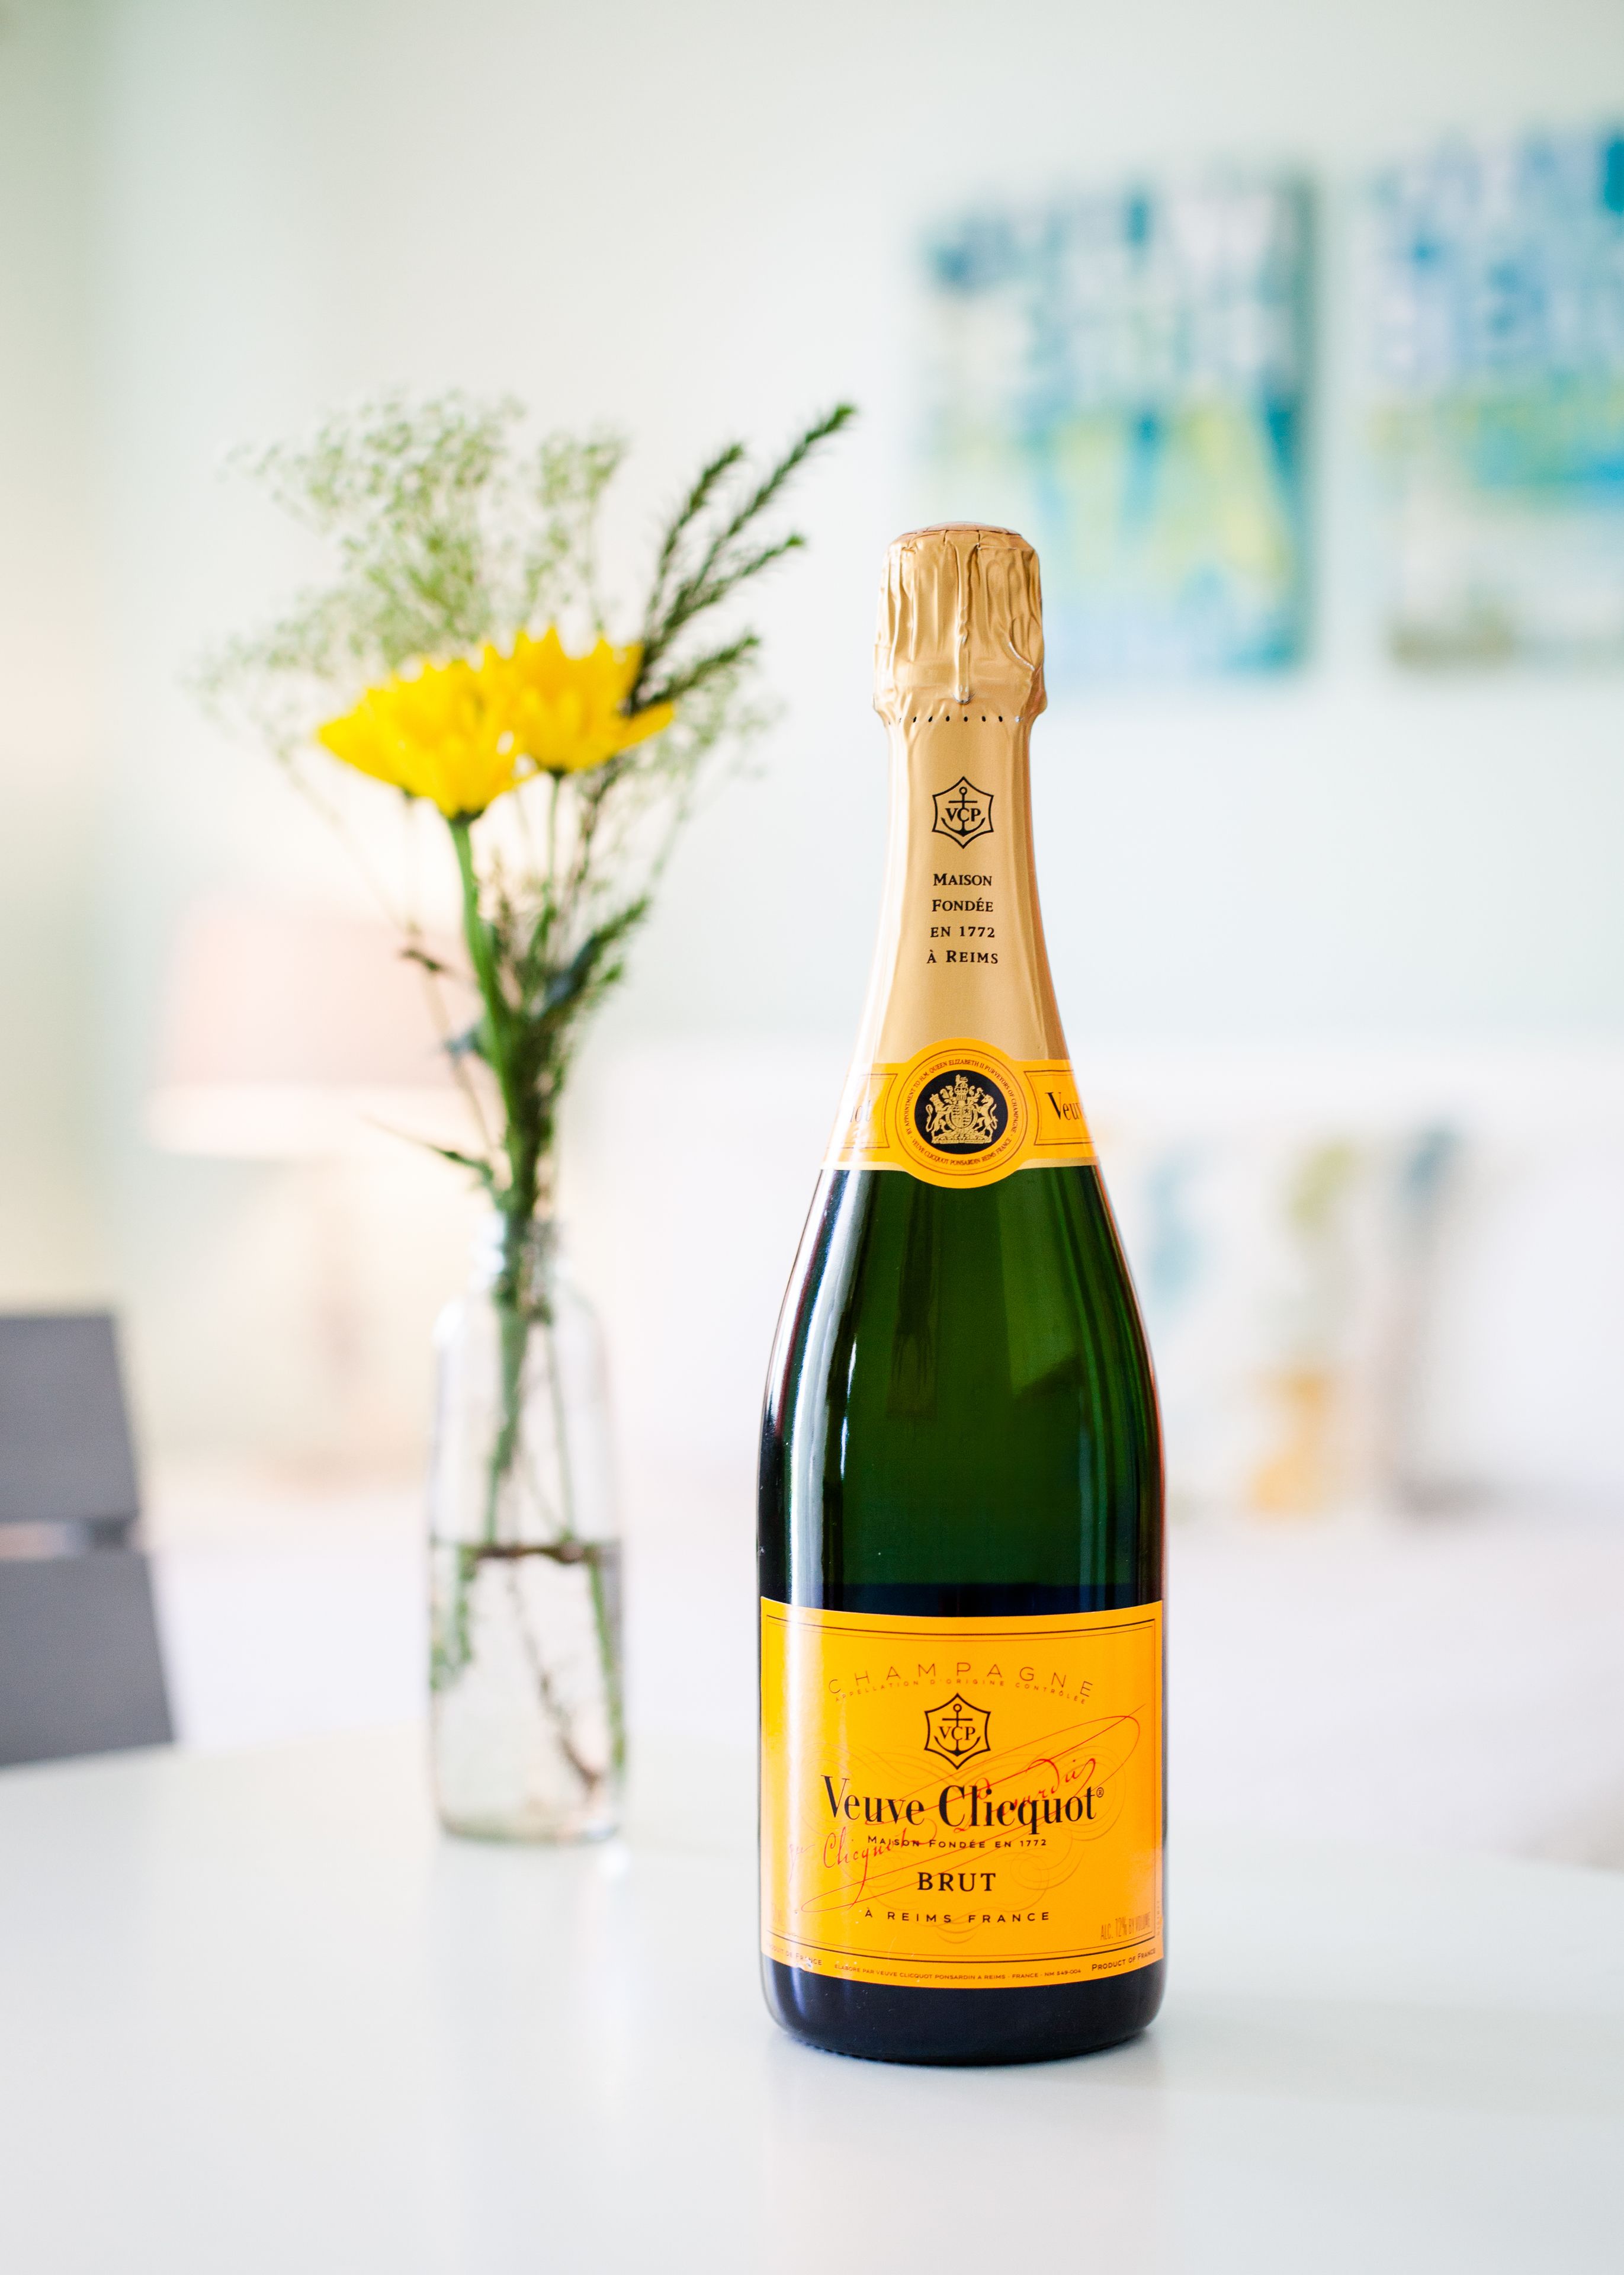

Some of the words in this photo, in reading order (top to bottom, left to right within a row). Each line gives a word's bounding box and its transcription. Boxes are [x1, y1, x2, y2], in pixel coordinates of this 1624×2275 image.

[945, 807, 981, 822] VCP
[933, 873, 993, 886] MAISON
[932, 897, 994, 912] FONDÉE
[930, 927, 951, 938] EN
[959, 926, 995, 938] 1772
[926, 950, 936, 964] À
[945, 950, 999, 964] REIMS
[929, 1061, 948, 1074] QUEEN
[912, 1138, 925, 1153] VEUVE
[995, 1137, 1012, 1155] FRANCE
[828, 1662, 1093, 1697] CHAMPAGNE
[836, 1680, 919, 1702] APPELLATION
[938, 1726, 976, 1741] VCP
[820, 1774, 925, 1826] Veuve
[994, 1840, 1012, 1848] EN
[1020, 1838, 1047, 1847] 1772
[917, 1872, 996, 1892] BRUT
[865, 1906, 873, 1918] À
[887, 1911, 952, 1924] REIMS
[968, 1911, 1050, 1923] FRANCE
